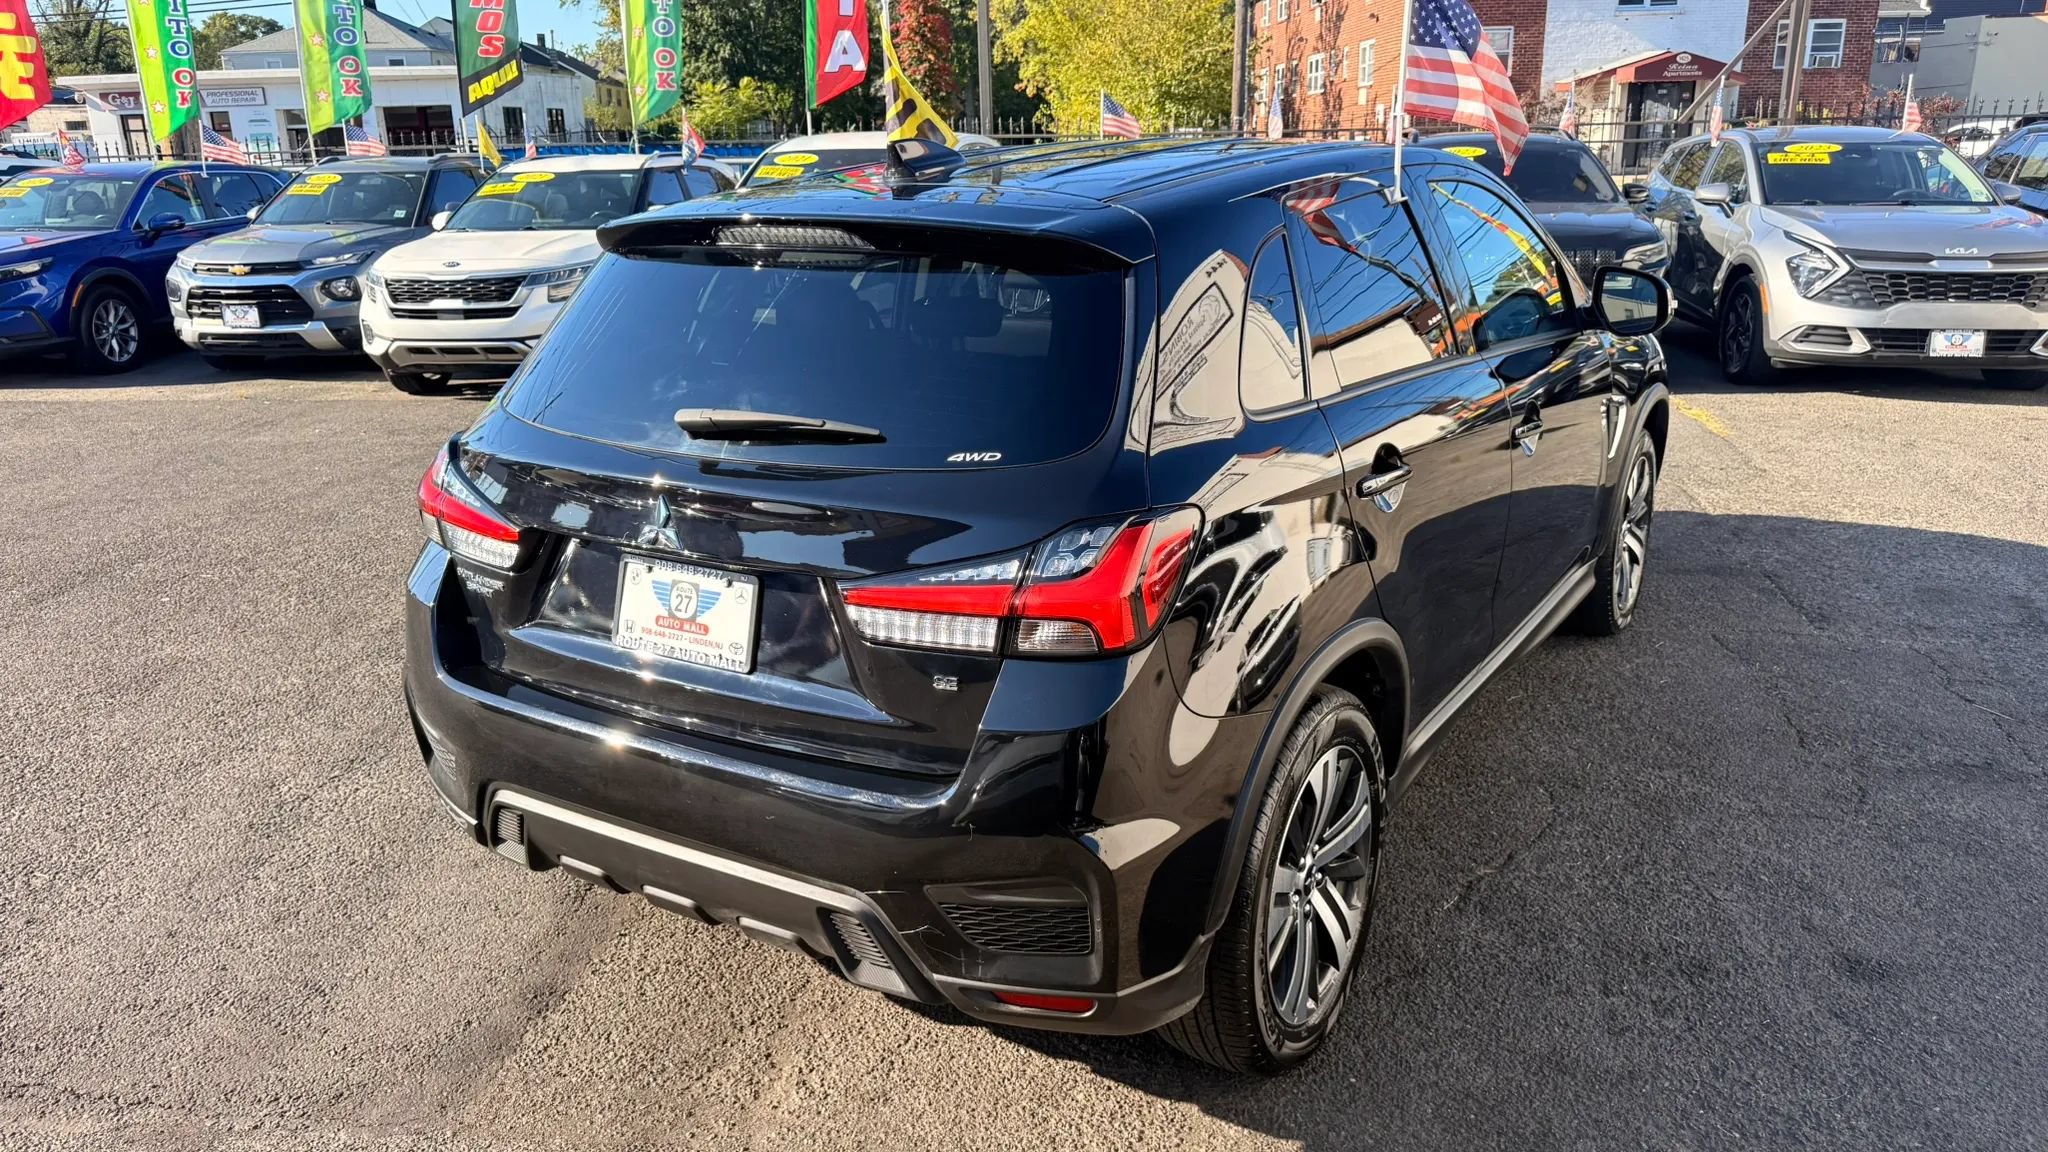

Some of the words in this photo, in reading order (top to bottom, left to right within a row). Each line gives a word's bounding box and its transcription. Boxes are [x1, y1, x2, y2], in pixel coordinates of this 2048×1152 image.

[337, 55, 363, 96] OK
[654, 47, 677, 91] OK
[172, 67, 195, 108] OK
[206, 90, 259, 98] PROFESSIONAL
[109, 93, 136, 108] G&J
[947, 452, 1002, 462] 4WD
[676, 586, 693, 595] ROUTE
[674, 593, 693, 614] 27
[641, 626, 684, 641] 908-648-2727
[657, 618, 681, 629] AUTO
[683, 622, 707, 634] MALL
[615, 634, 656, 656] ROUTE
[673, 647, 707, 664] AUTO
[709, 653, 745, 673] MALL
[933, 676, 958, 691] SE
